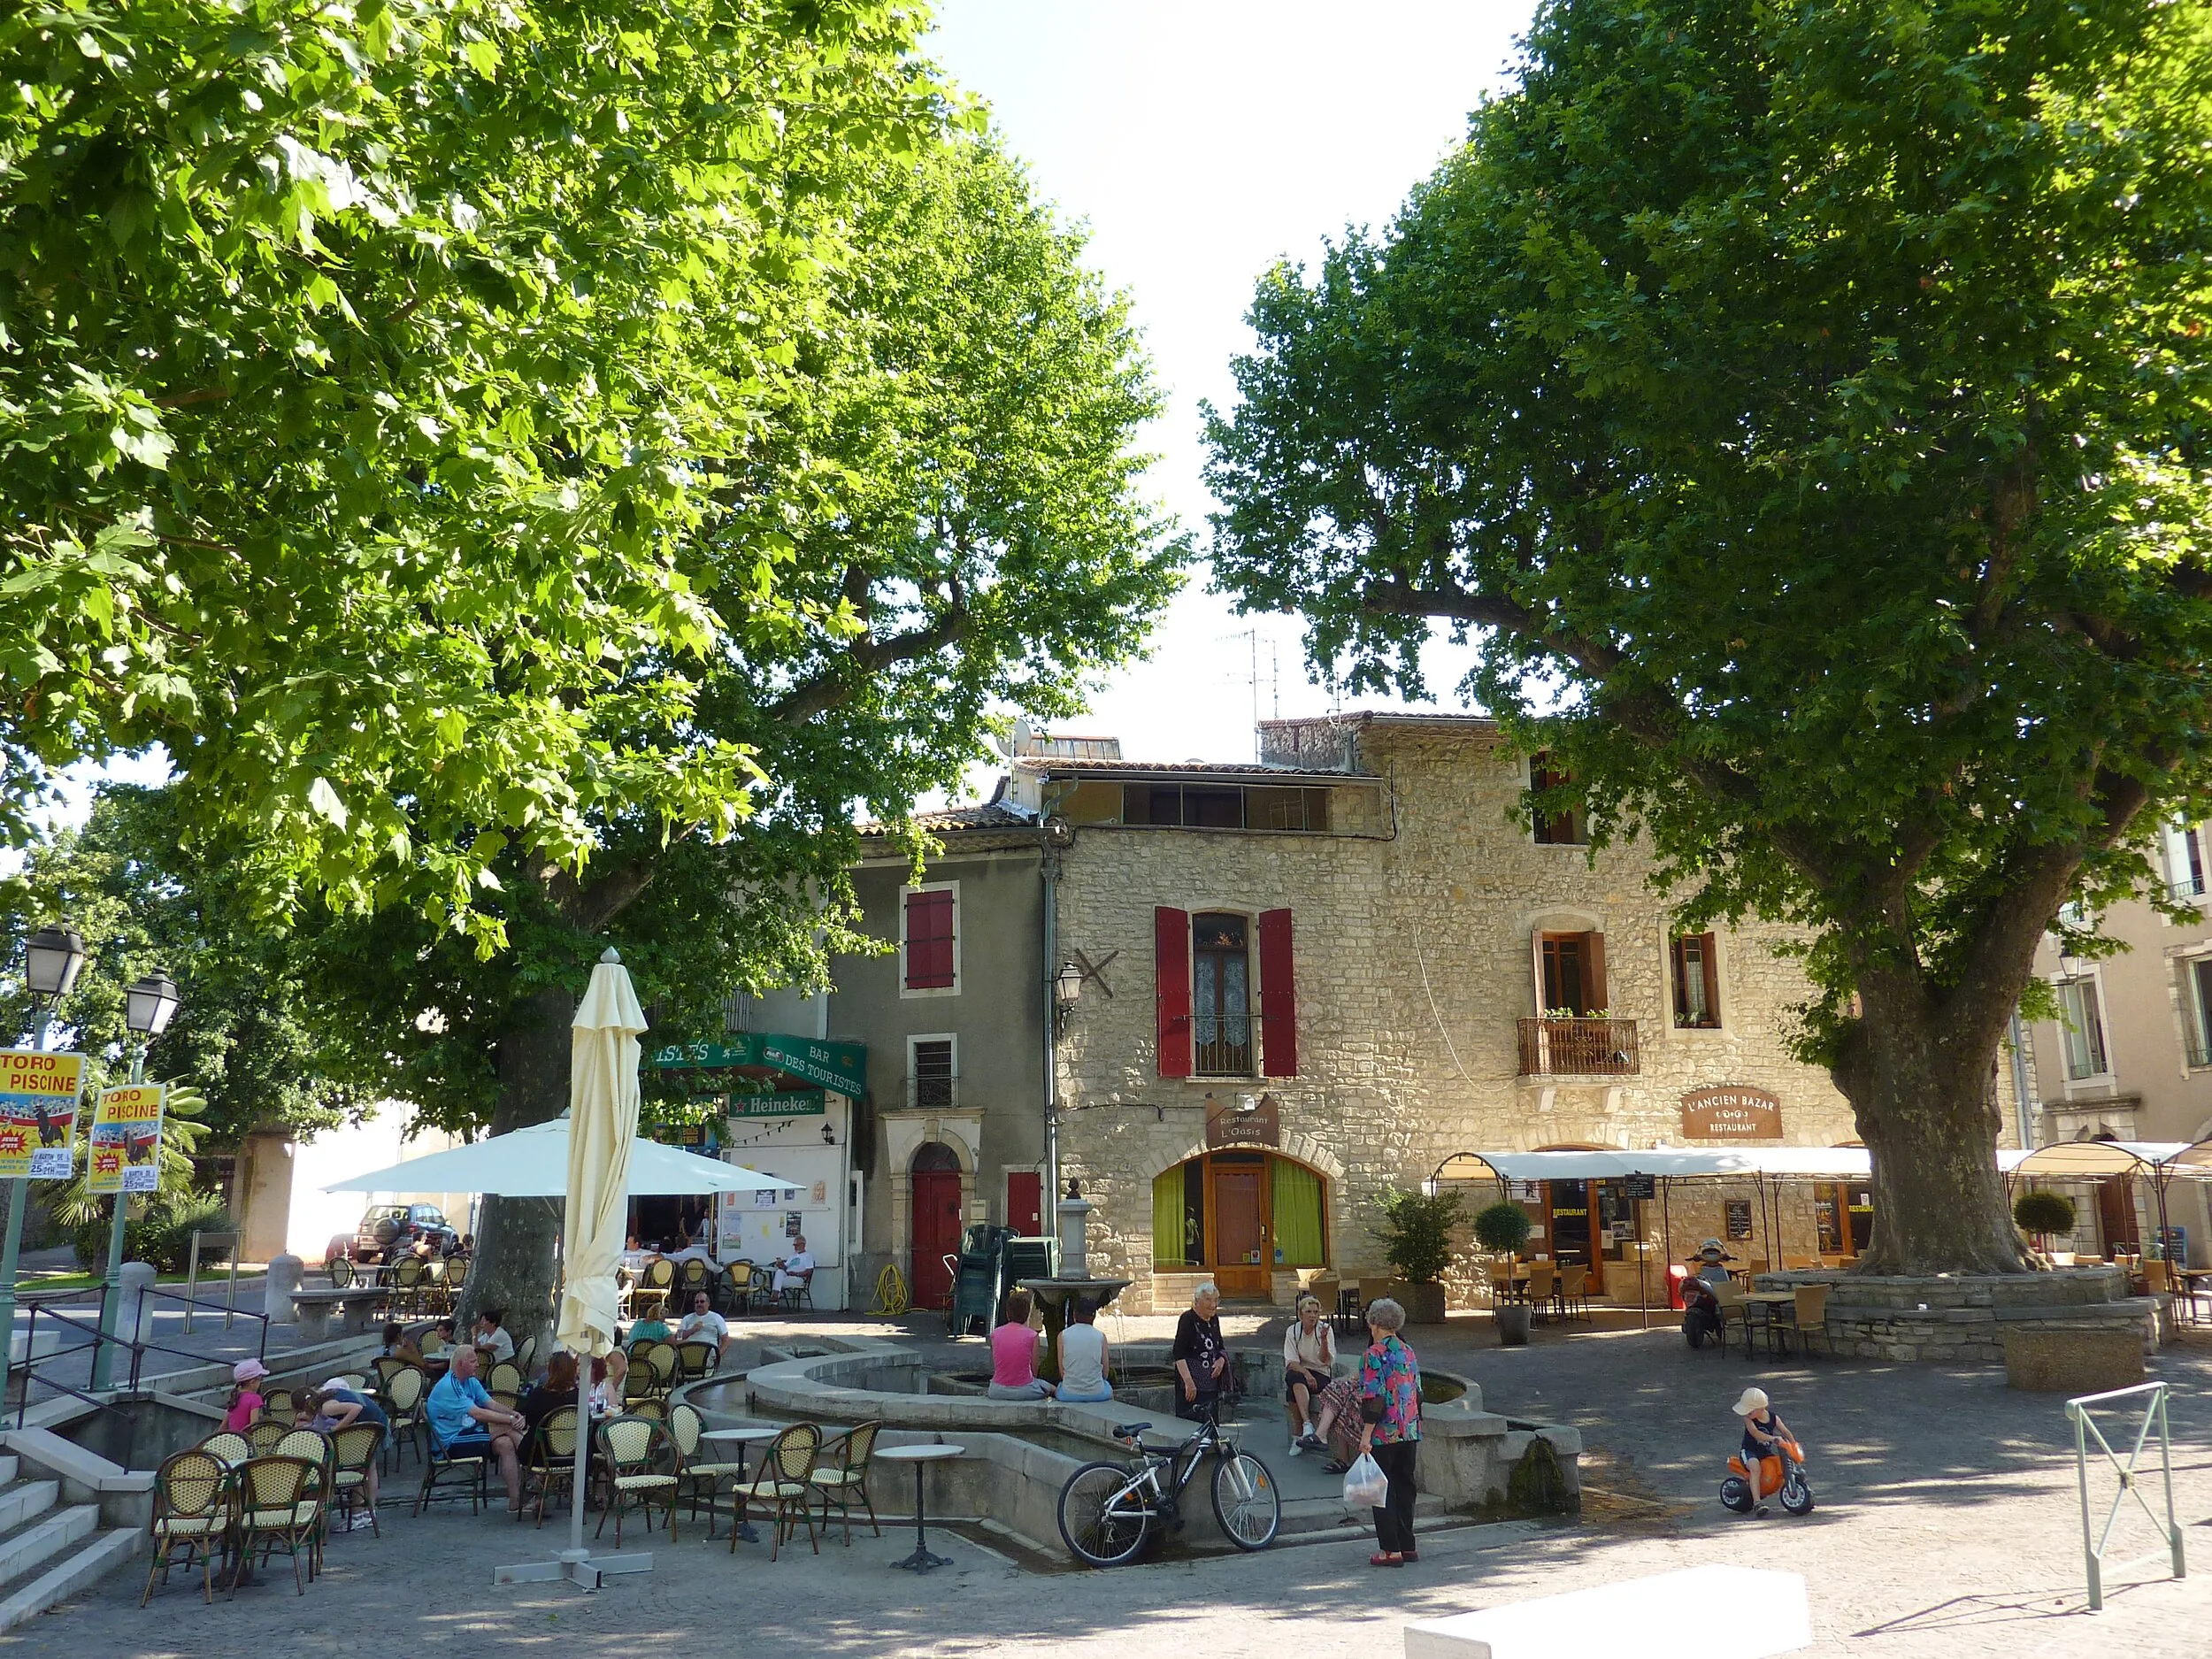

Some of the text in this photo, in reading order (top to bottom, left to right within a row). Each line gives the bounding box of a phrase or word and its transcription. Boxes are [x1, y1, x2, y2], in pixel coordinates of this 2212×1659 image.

[810, 1046, 830, 1064] BAR
[0, 1055, 57, 1071] TORO
[785, 1054, 862, 1095] DES TOURISTES
[10, 1073, 76, 1092] PISCINE
[103, 1089, 142, 1104] TORO
[749, 1095, 815, 1113] Heineken
[1687, 1094, 1774, 1112] L'ANCIEN BAZAR
[107, 1104, 158, 1119] PISCINE
[1220, 1116, 1269, 1125] Restaurant
[1709, 1123, 1756, 1132] RESTAURANT
[1221, 1127, 1261, 1138] L'Oasis
[31, 1164, 42, 1173] 25
[1553, 1208, 1588, 1218] RESTAURANT
